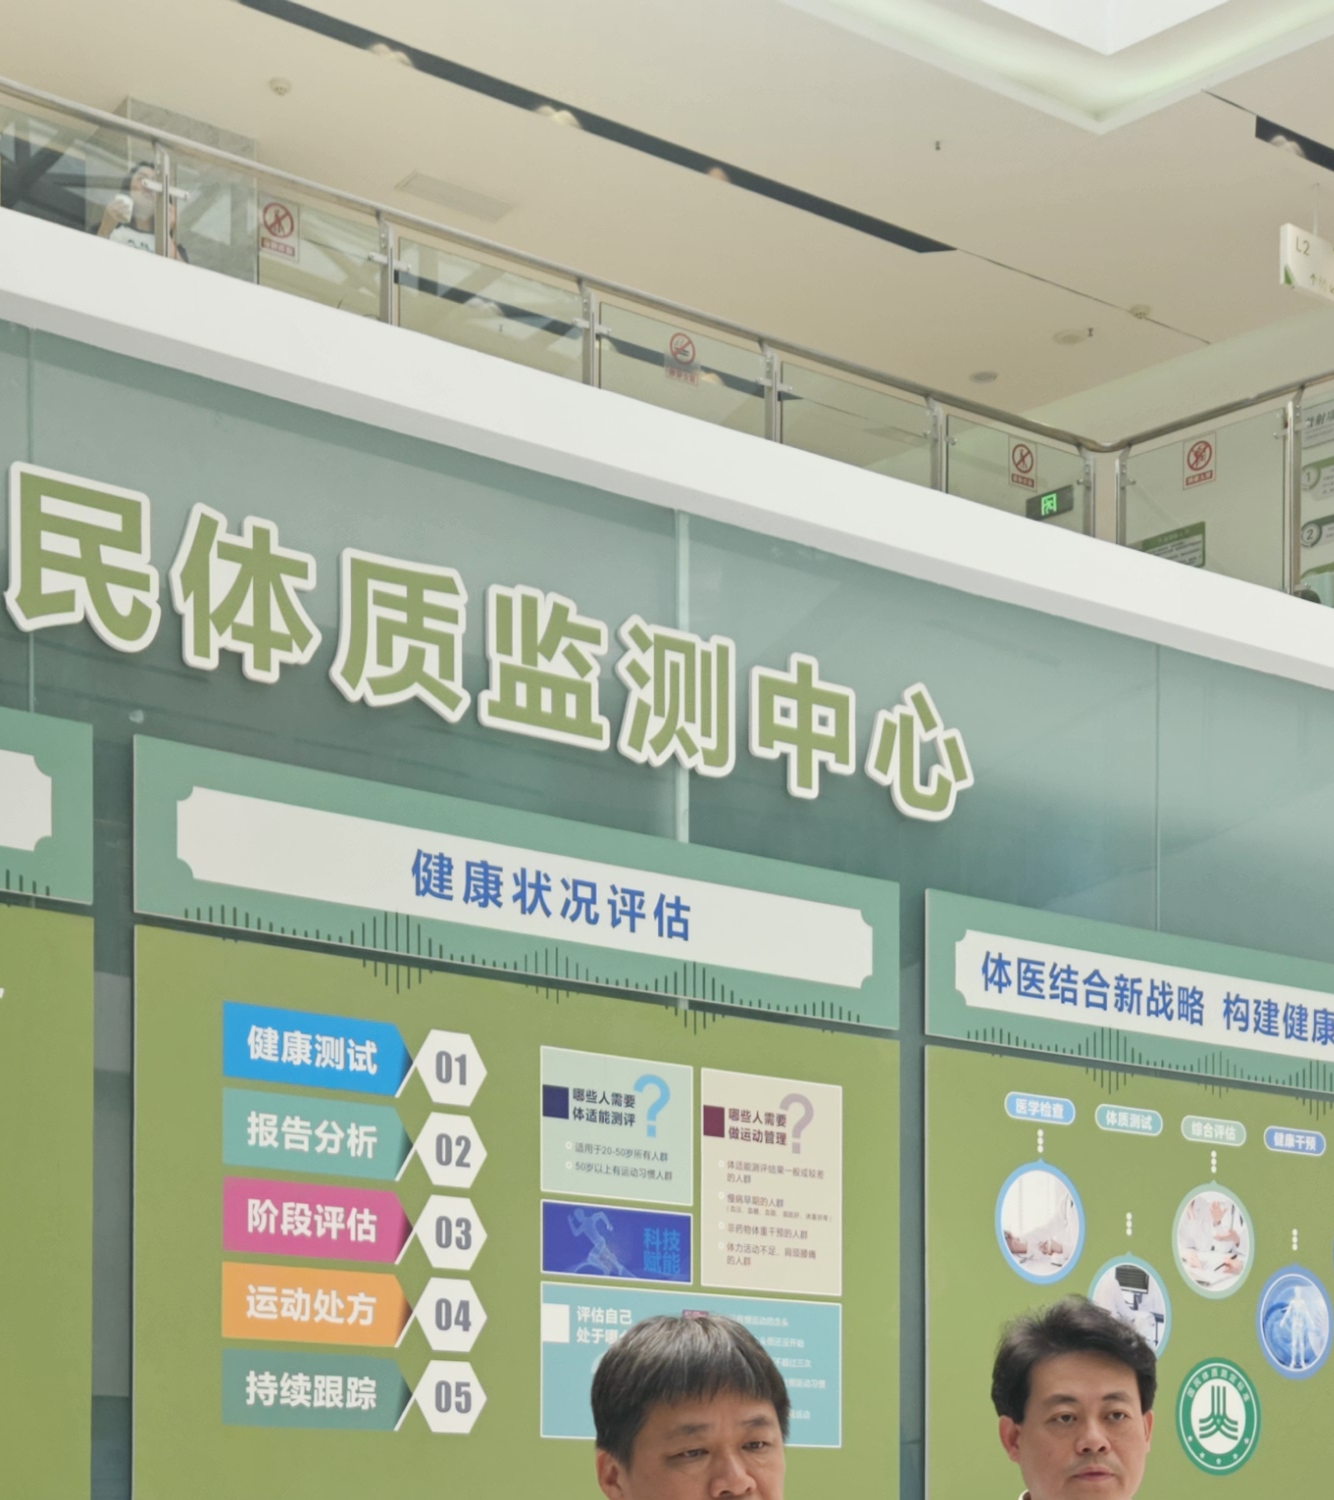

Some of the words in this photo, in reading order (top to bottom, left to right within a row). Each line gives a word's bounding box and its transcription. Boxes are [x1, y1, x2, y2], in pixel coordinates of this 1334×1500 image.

[411, 848, 691, 943] 健康状况评估
[982, 950, 1205, 1028] 体医结合新战略
[247, 1024, 378, 1076] 健康测试
[434, 1050, 468, 1087] 01
[572, 1087, 636, 1109] 哪些人需要
[1015, 1098, 1064, 1120] 医学检查
[572, 1106, 636, 1128] 体适能测评
[728, 1107, 787, 1128] 哪些人需要
[1105, 1109, 1153, 1131] 体质测试
[1191, 1120, 1237, 1142] 综合评估
[247, 1111, 378, 1160] 报告分析
[434, 1132, 472, 1169] 02
[728, 1127, 787, 1146] 做运动管理
[1273, 1131, 1317, 1152] 健康干预
[247, 1198, 378, 1243] 阶段评估
[434, 1214, 473, 1250] 03
[642, 1227, 680, 1251] 科技
[642, 1252, 681, 1276] 赋能
[246, 1285, 377, 1327] 运动处方
[434, 1297, 472, 1334] 04
[576, 1305, 633, 1325] 评估自己
[246, 1368, 378, 1412] 持续跟踪
[434, 1380, 473, 1415] 05
